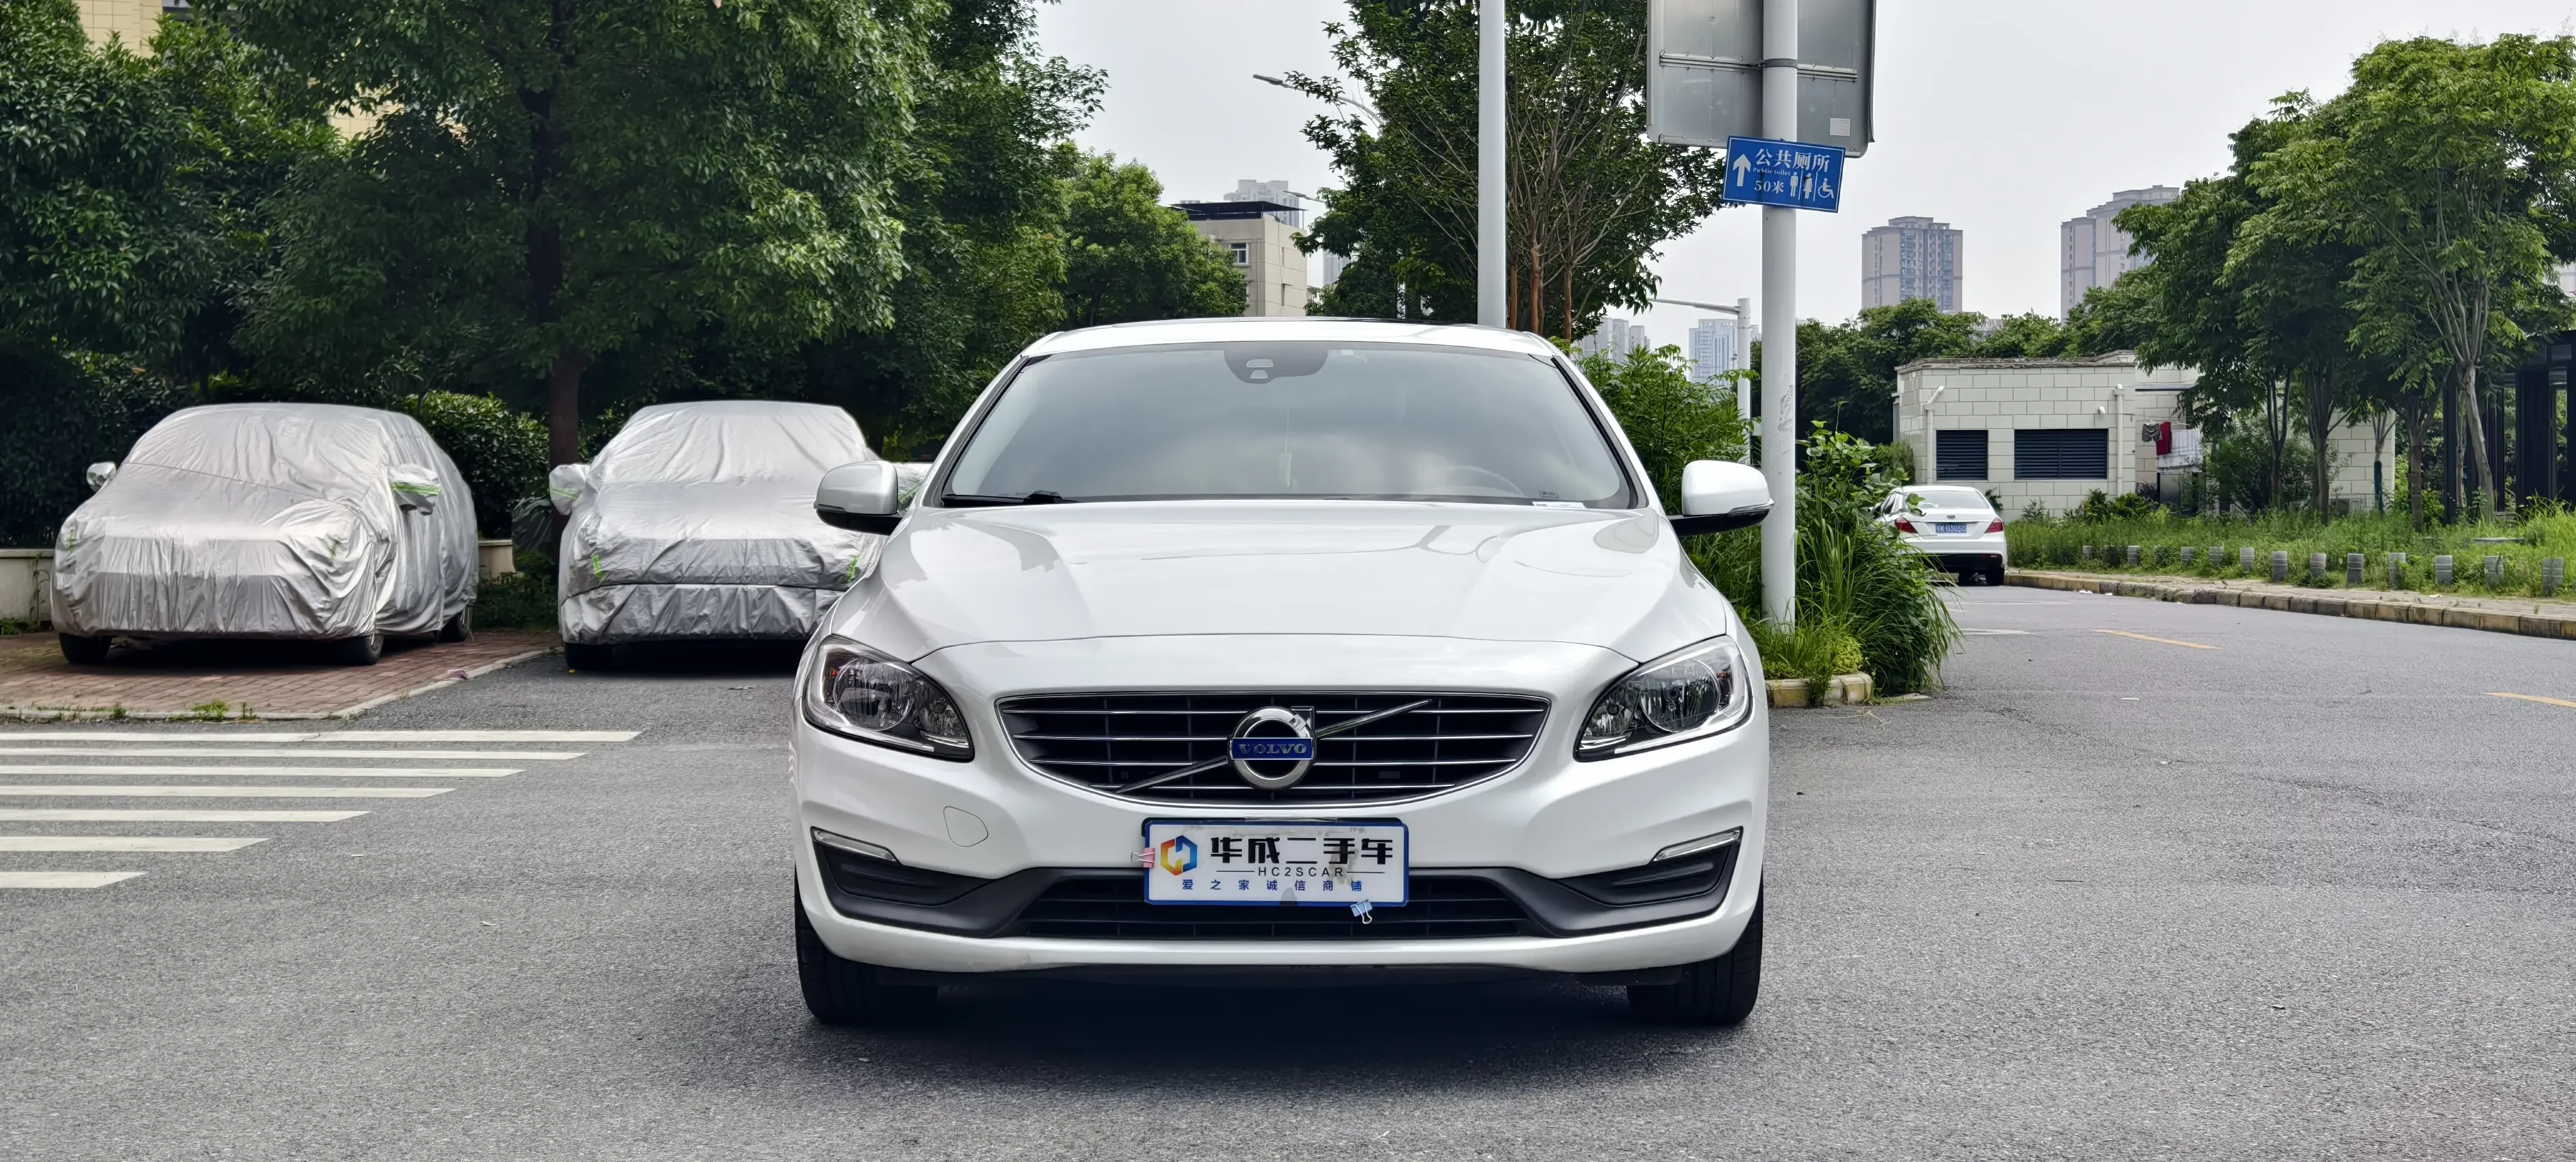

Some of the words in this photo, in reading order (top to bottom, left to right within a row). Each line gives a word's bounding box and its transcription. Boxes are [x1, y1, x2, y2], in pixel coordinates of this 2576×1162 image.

[1755, 148, 1830, 172] 公共厕所
[1755, 180, 1784, 194] 50米
[1238, 744, 1306, 754] VOLVO
[1211, 837, 1393, 865] 华成二手车
[1258, 866, 1343, 877] HC2SCAR
